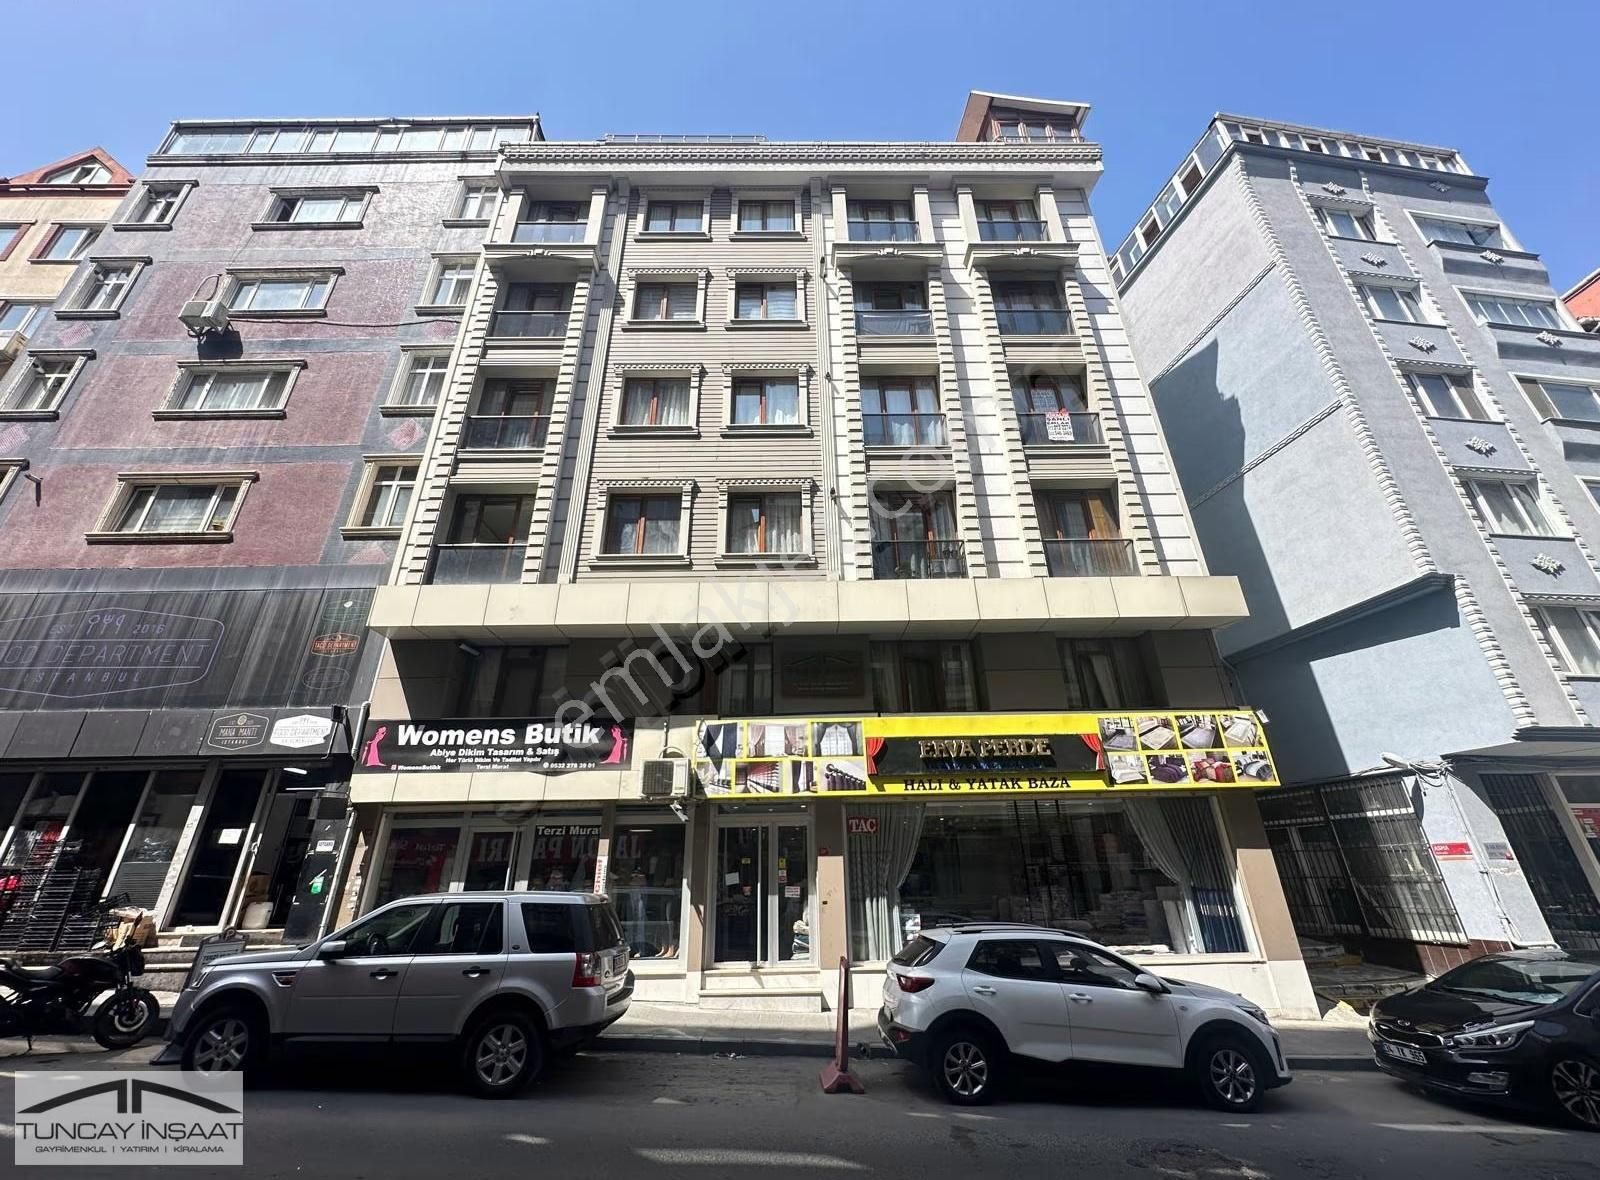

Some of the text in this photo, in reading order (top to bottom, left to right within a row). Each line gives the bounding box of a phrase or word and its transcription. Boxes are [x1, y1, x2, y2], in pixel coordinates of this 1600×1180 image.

[47, 644, 209, 664] DEPARTMENT
[397, 722, 600, 746] Womens Butik
[430, 747, 560, 758] Abiye Dikim Tasarım & Satış
[919, 738, 1052, 758] ERVA PERDE
[903, 776, 1071, 791] HALI & YATAK BAZA
[538, 826, 566, 836] Terzi
